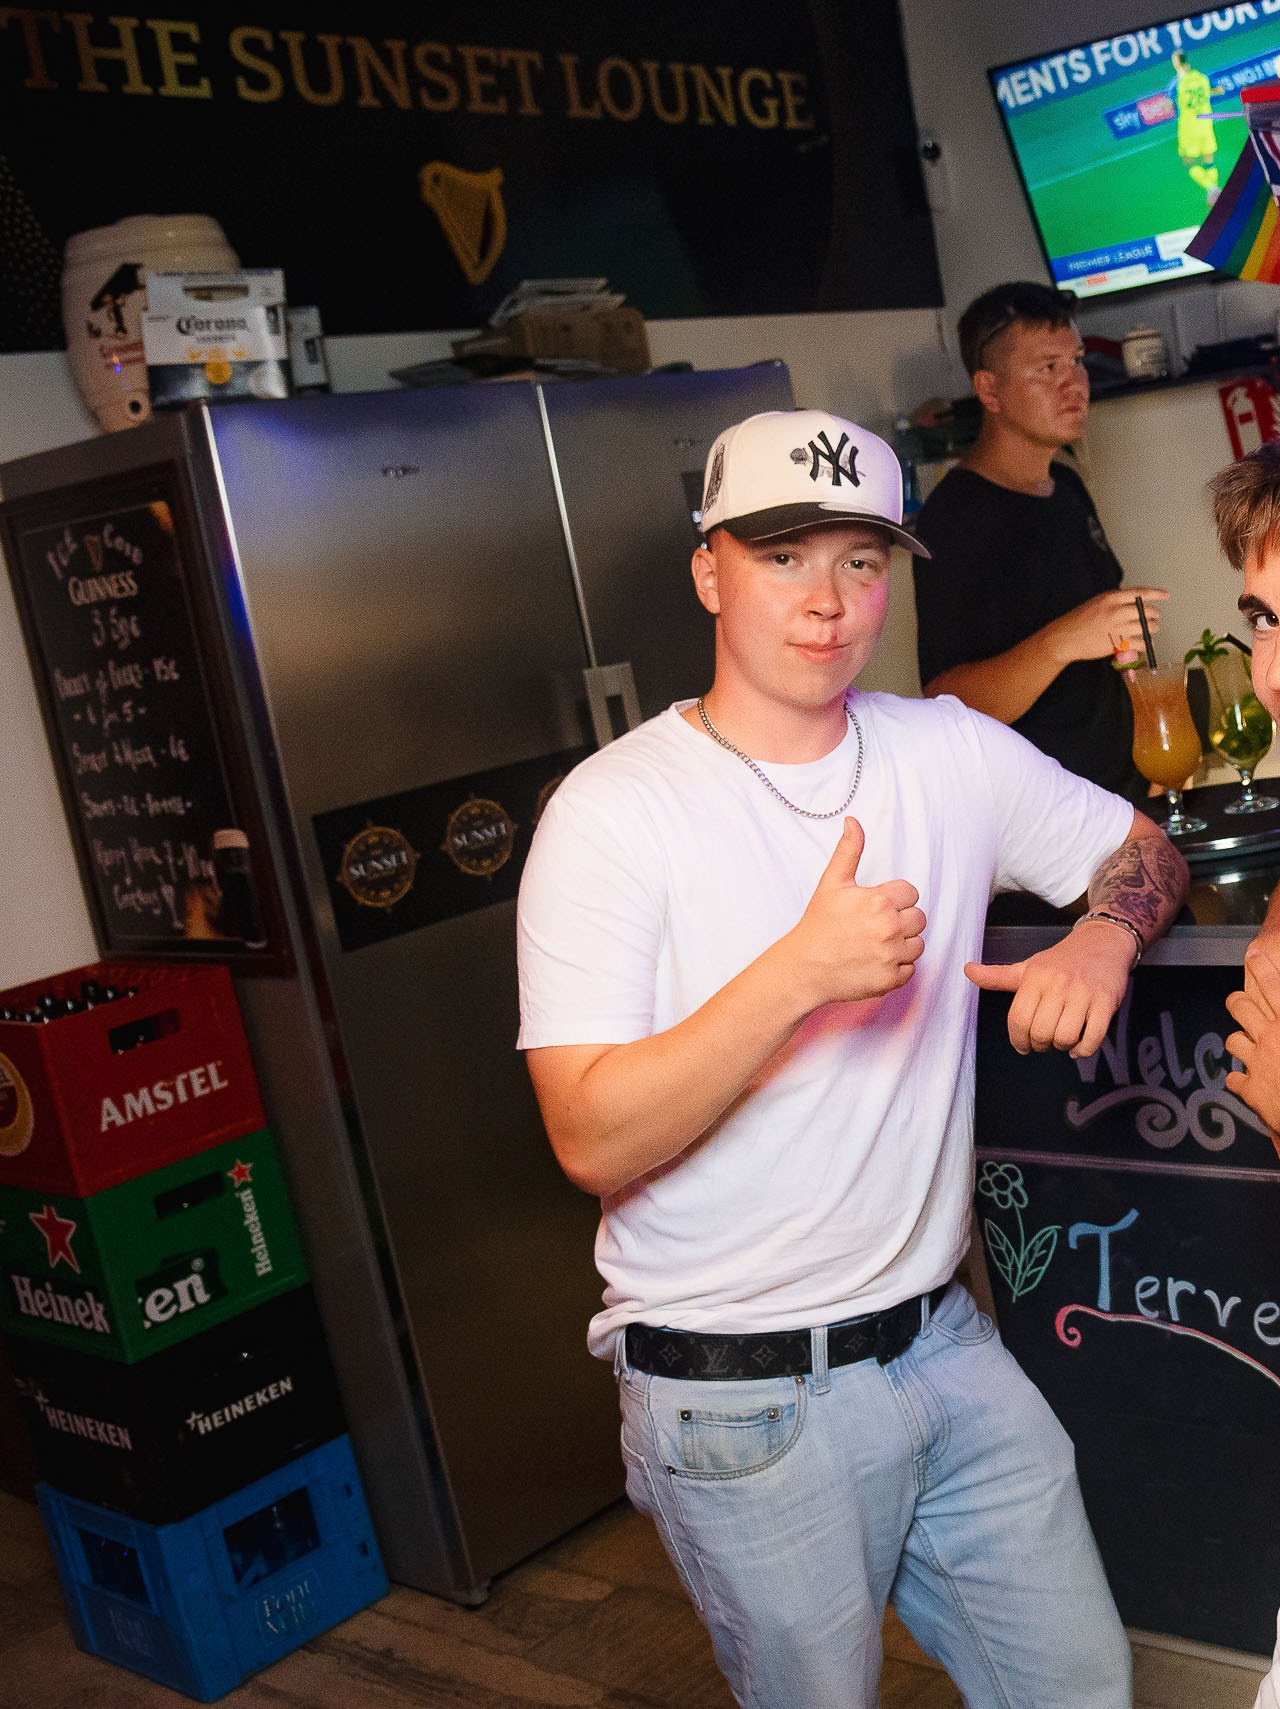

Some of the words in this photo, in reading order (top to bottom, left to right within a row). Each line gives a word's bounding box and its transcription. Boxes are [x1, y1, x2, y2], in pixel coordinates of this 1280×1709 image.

[0, 6, 213, 99] THE
[229, 25, 544, 118] SUNSET
[566, 53, 816, 132] LOUNGE
[1091, 28, 1161, 76] FOR
[175, 316, 248, 335] Corona
[807, 430, 860, 488] NY
[67, 570, 140, 606] GUINNESS
[100, 1061, 229, 1133] AMSTEL
[235, 1189, 274, 1278] Heineken
[46, 1406, 132, 1451] HEINEKEN
[199, 1376, 294, 1436] HEINEKEN
